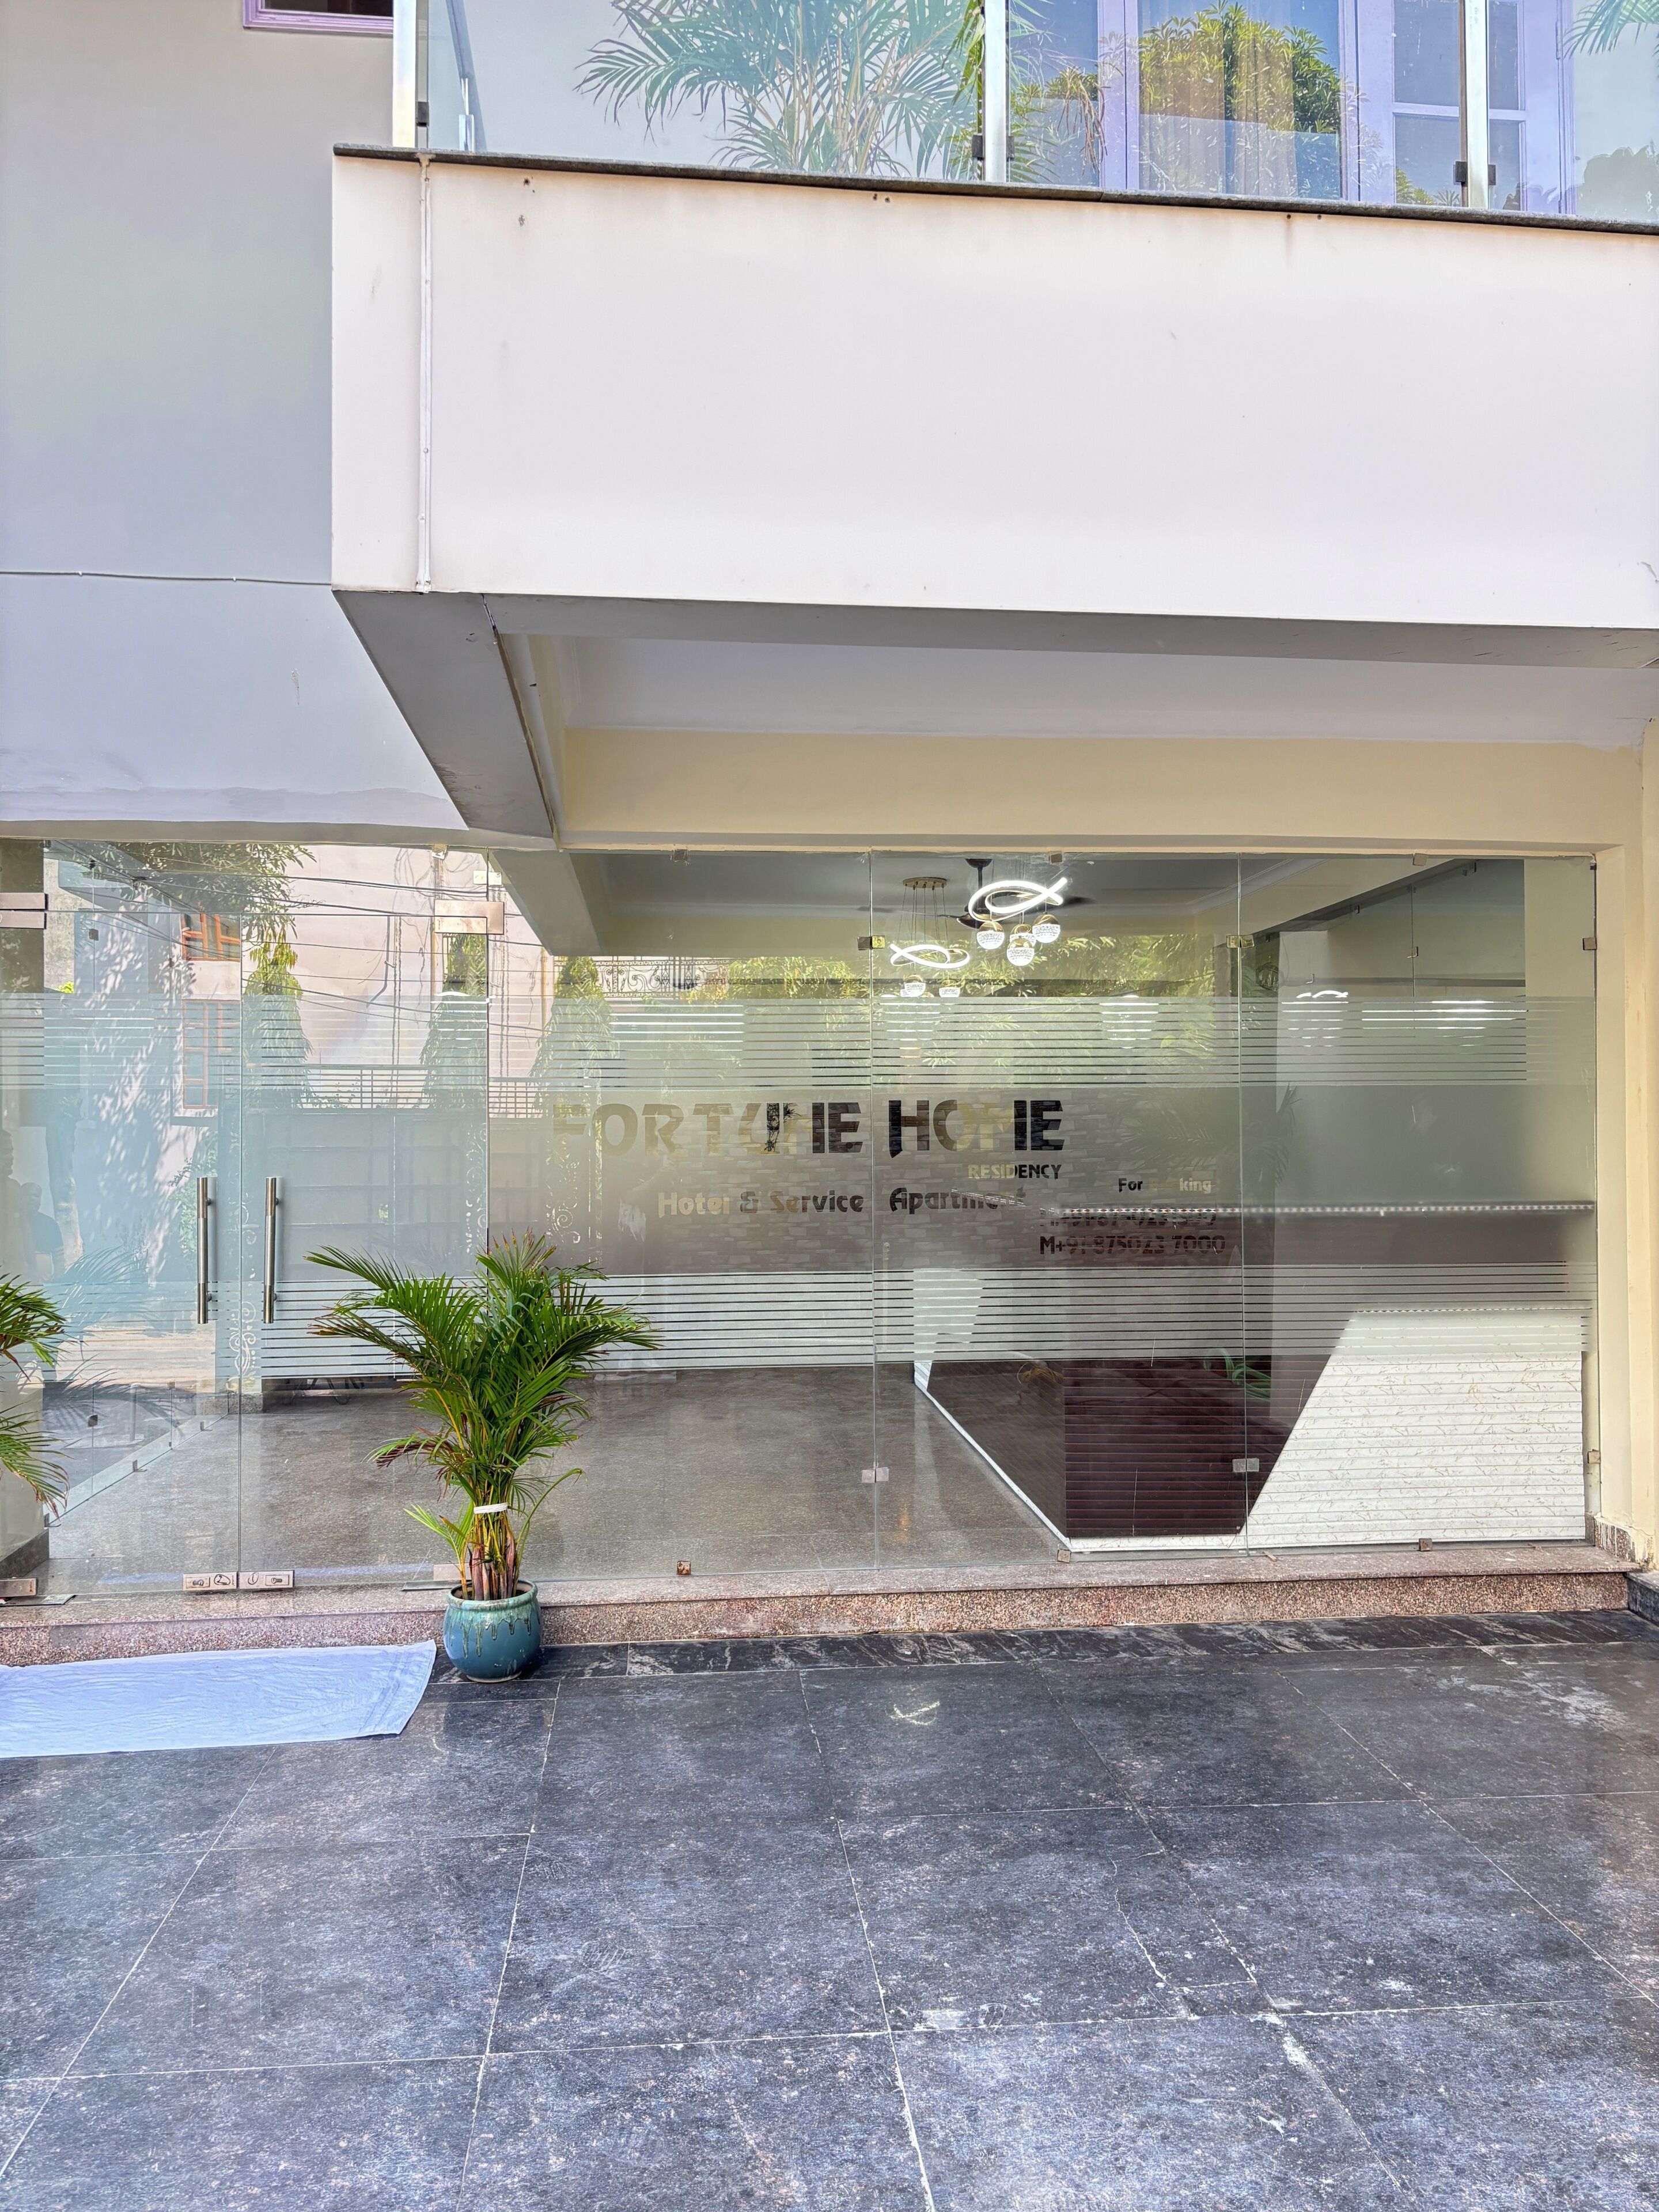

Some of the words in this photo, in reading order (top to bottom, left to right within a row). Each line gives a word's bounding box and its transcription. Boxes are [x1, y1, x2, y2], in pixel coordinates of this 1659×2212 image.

[552, 1101, 863, 1156] FORTUNE
[889, 1100, 1065, 1158] HOME
[968, 1164, 1062, 1180] RESIDENCY
[1119, 1177, 1143, 1192] For
[658, 1192, 730, 1217] Hotel
[740, 1191, 759, 1214] &
[770, 1190, 863, 1214] Service
[1171, 1234, 1226, 1255] 7000
